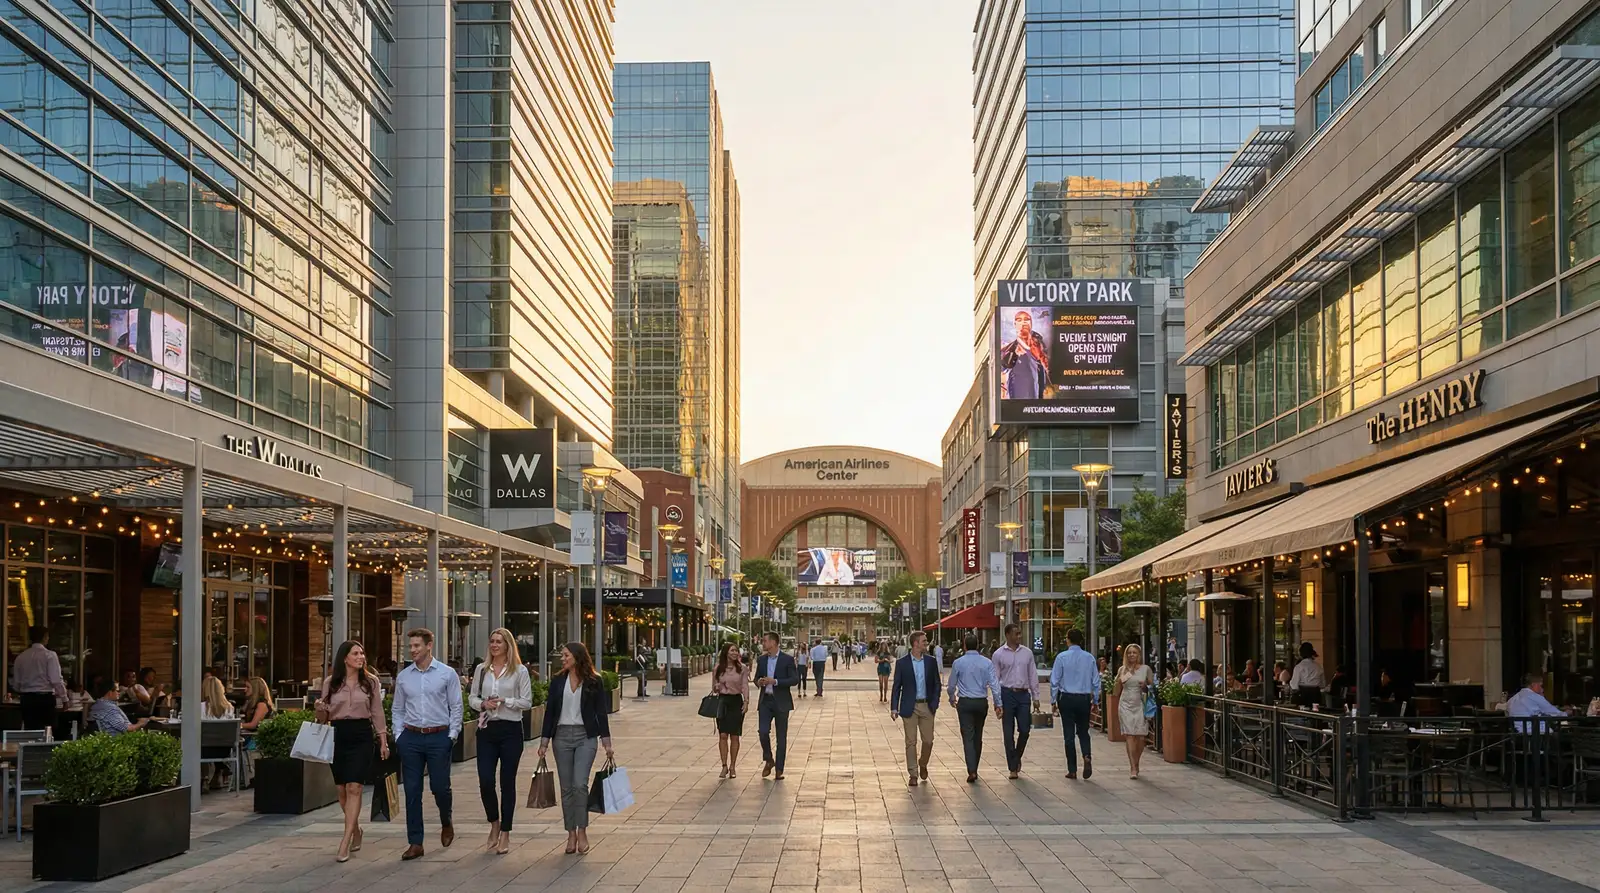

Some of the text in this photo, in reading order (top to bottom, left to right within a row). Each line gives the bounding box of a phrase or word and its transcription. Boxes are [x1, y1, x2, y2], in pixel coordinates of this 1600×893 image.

[1007, 282, 1133, 302] VICTORY PARK
[1366, 370, 1480, 445] The HENRY
[257, 436, 277, 464] W
[1172, 397, 1182, 475] JAVIER'S
[501, 453, 541, 483] W
[784, 458, 890, 470] American Airlines
[816, 470, 858, 481] Center
[497, 488, 546, 498] DALLAS
[1224, 457, 1273, 501] JAVIER'S
